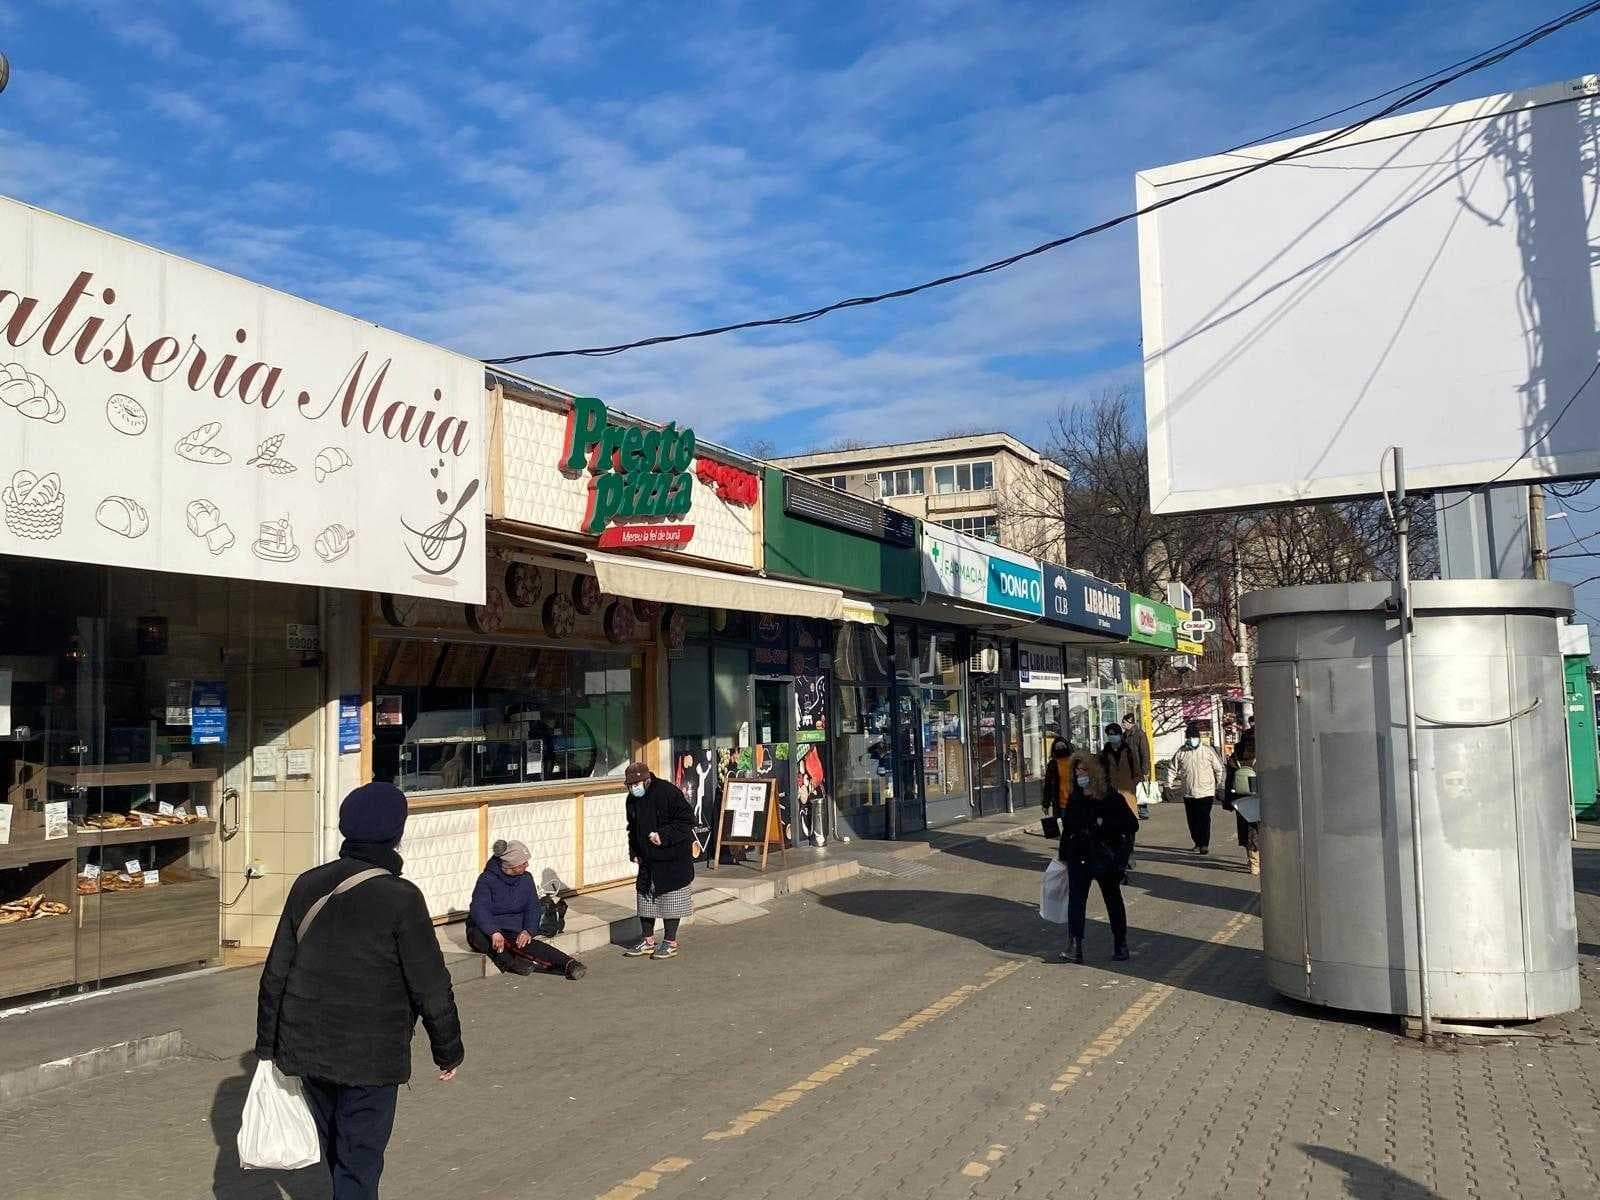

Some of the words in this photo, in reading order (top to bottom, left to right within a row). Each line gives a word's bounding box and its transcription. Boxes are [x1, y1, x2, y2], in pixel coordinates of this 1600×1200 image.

[297, 350, 471, 457] Maia
[564, 397, 696, 474] Presto
[586, 472, 693, 534] pizza
[944, 559, 984, 584] FARMACIA
[1000, 572, 1029, 600] DONA
